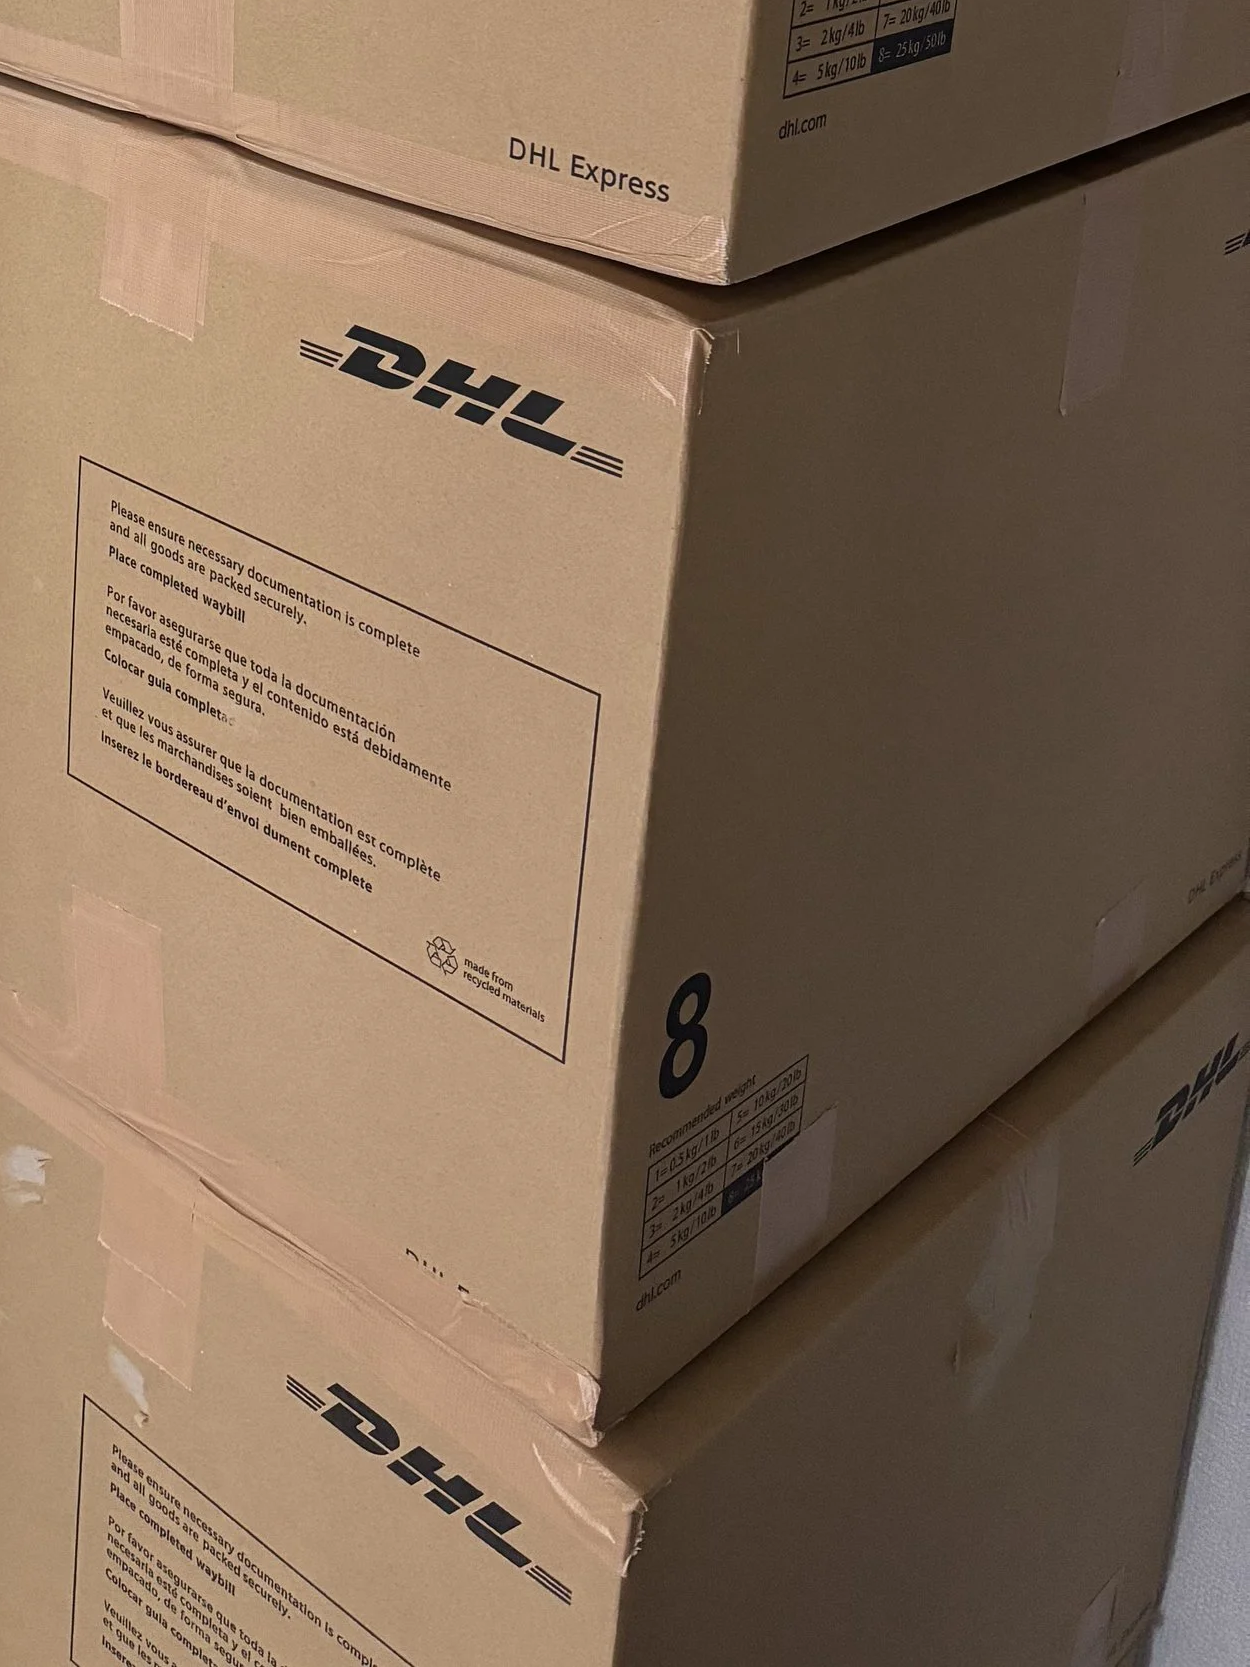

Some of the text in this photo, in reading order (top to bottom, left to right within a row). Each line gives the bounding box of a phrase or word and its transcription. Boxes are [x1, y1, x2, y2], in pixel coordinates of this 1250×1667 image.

[507, 134, 671, 205] DHL Express
[778, 112, 827, 140] dhl.com
[338, 324, 577, 456] DHL
[109, 545, 245, 624] Place completed waybill
[111, 499, 420, 658] Please ensure necessary documentation is complete
[464, 958, 513, 991] made from
[464, 970, 545, 1022] recycled materials
[658, 972, 712, 1100] 8
[1153, 1032, 1240, 1151] DHL
[321, 1383, 531, 1568] DHL
